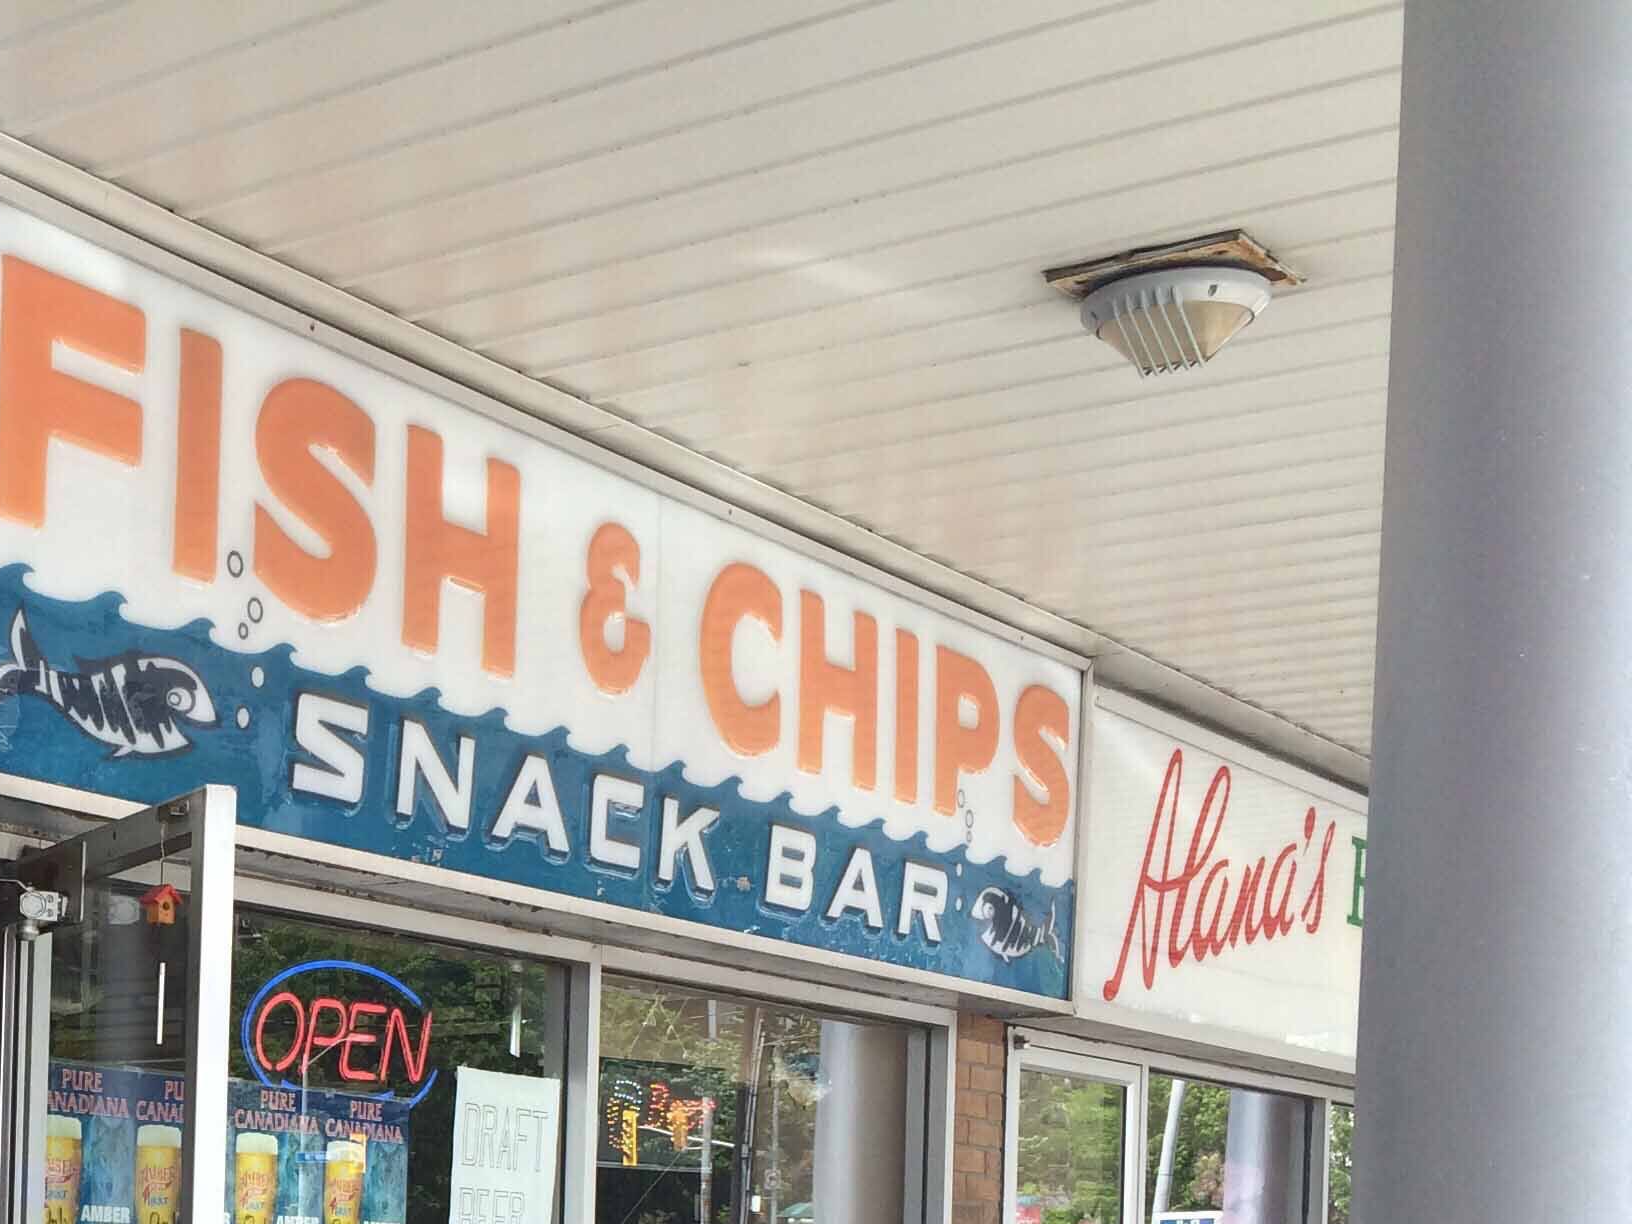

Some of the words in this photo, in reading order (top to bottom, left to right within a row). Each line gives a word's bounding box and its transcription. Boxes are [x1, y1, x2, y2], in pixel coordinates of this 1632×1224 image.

[579, 521, 651, 697] &
[699, 561, 1070, 848] CHIPS
[291, 691, 720, 892] SNACK
[765, 823, 950, 945] BAR
[1103, 748, 1336, 1002] Alana's
[255, 991, 433, 1083] OPEN
[61, 1069, 103, 1093] PURE
[164, 1080, 184, 1101] PU
[48, 1090, 129, 1118] ANADIANA
[261, 1090, 296, 1112] PURE
[350, 1101, 383, 1121] PURE
[234, 1109, 319, 1135] CANADIANA
[325, 1119, 404, 1144] CANADIANA
[461, 1102, 549, 1173] DRAFT
[81, 1205, 130, 1224] AMBER
